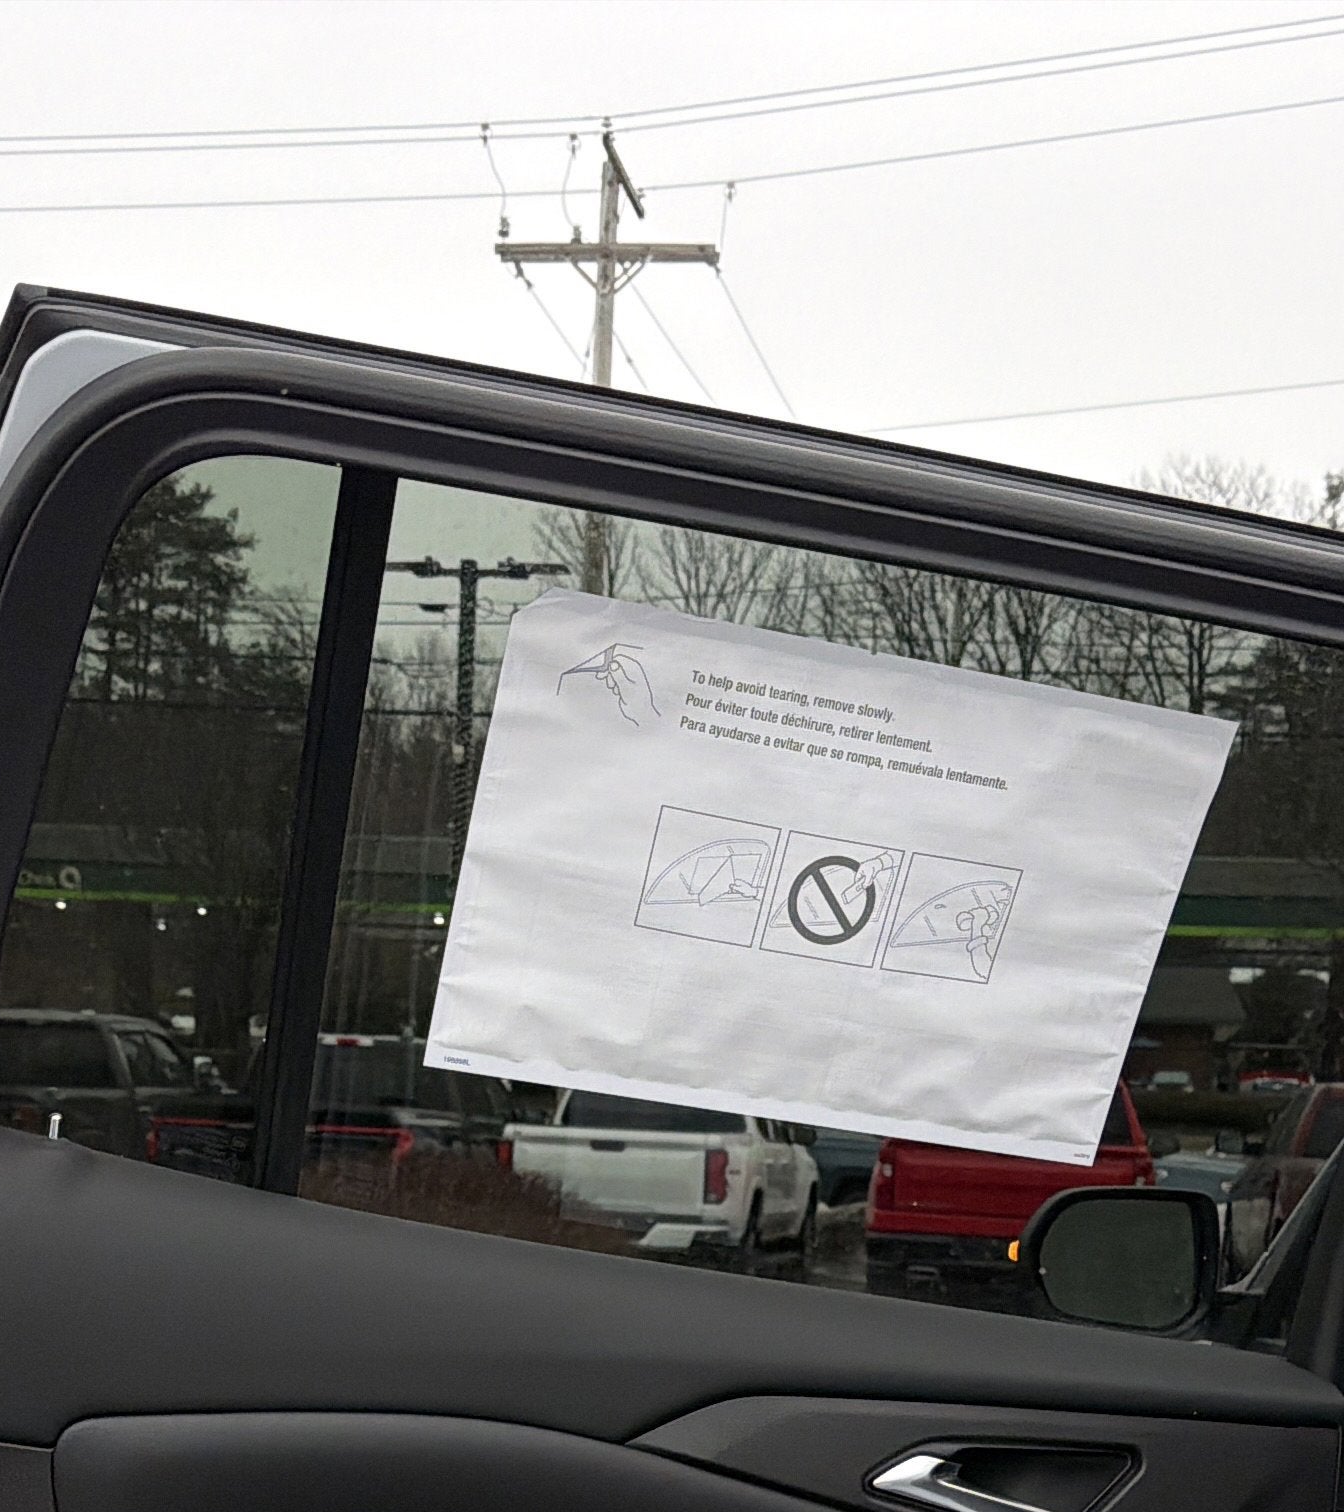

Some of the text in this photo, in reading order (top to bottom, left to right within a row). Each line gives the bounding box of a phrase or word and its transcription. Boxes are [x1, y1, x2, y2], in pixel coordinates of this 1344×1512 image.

[685, 693, 933, 753] Pour éviter toute déchirure, retirer lentement.
[692, 670, 895, 723] To help avoid tearing, remove slowly.
[680, 715, 1009, 791] Para ayudarse a evitar que se rompa, remuévala lentamente.
